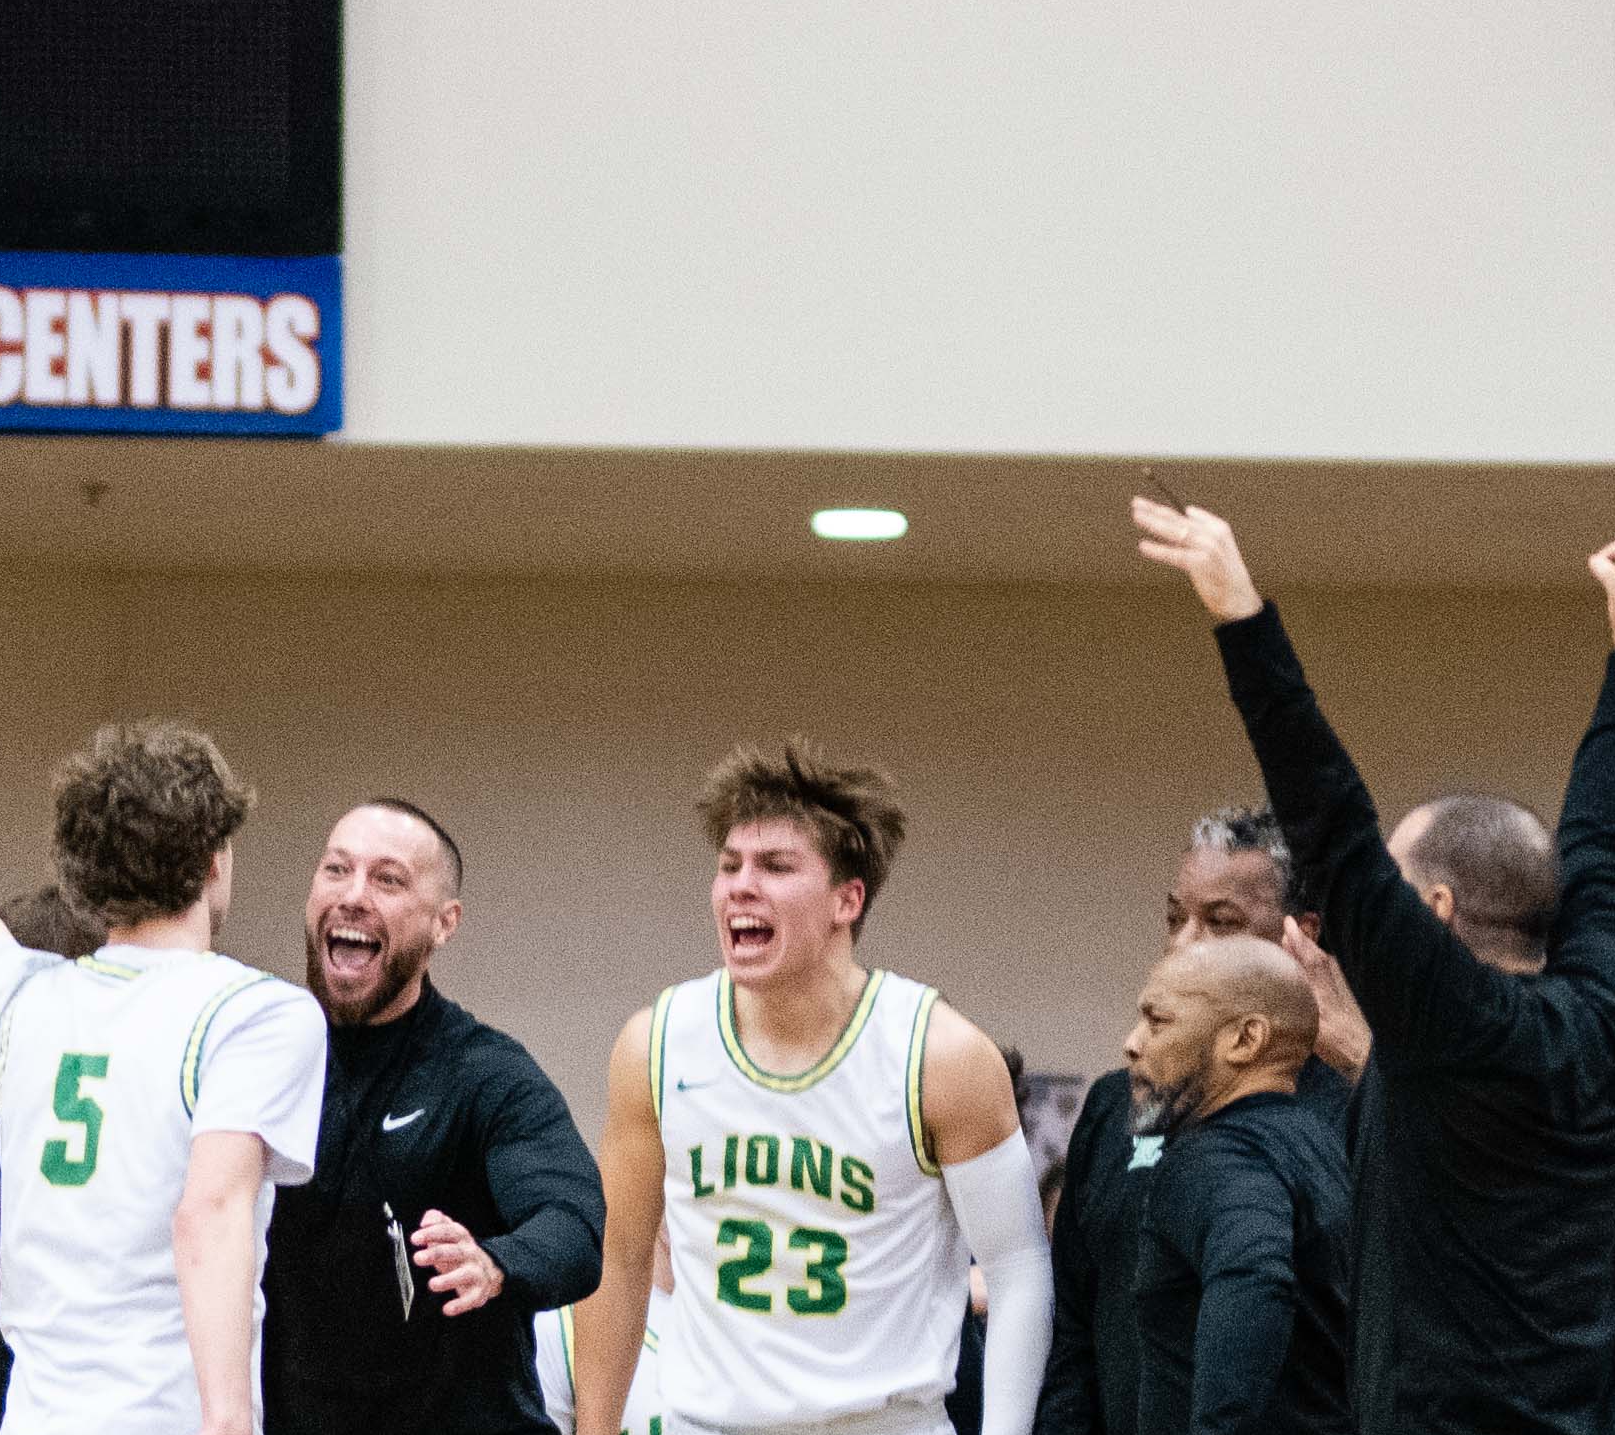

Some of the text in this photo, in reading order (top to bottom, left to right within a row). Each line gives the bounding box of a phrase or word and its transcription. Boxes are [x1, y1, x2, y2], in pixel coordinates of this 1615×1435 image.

[39, 1051, 111, 1187] 5
[688, 1133, 876, 1214] LIONS
[715, 1216, 849, 1319] 23
